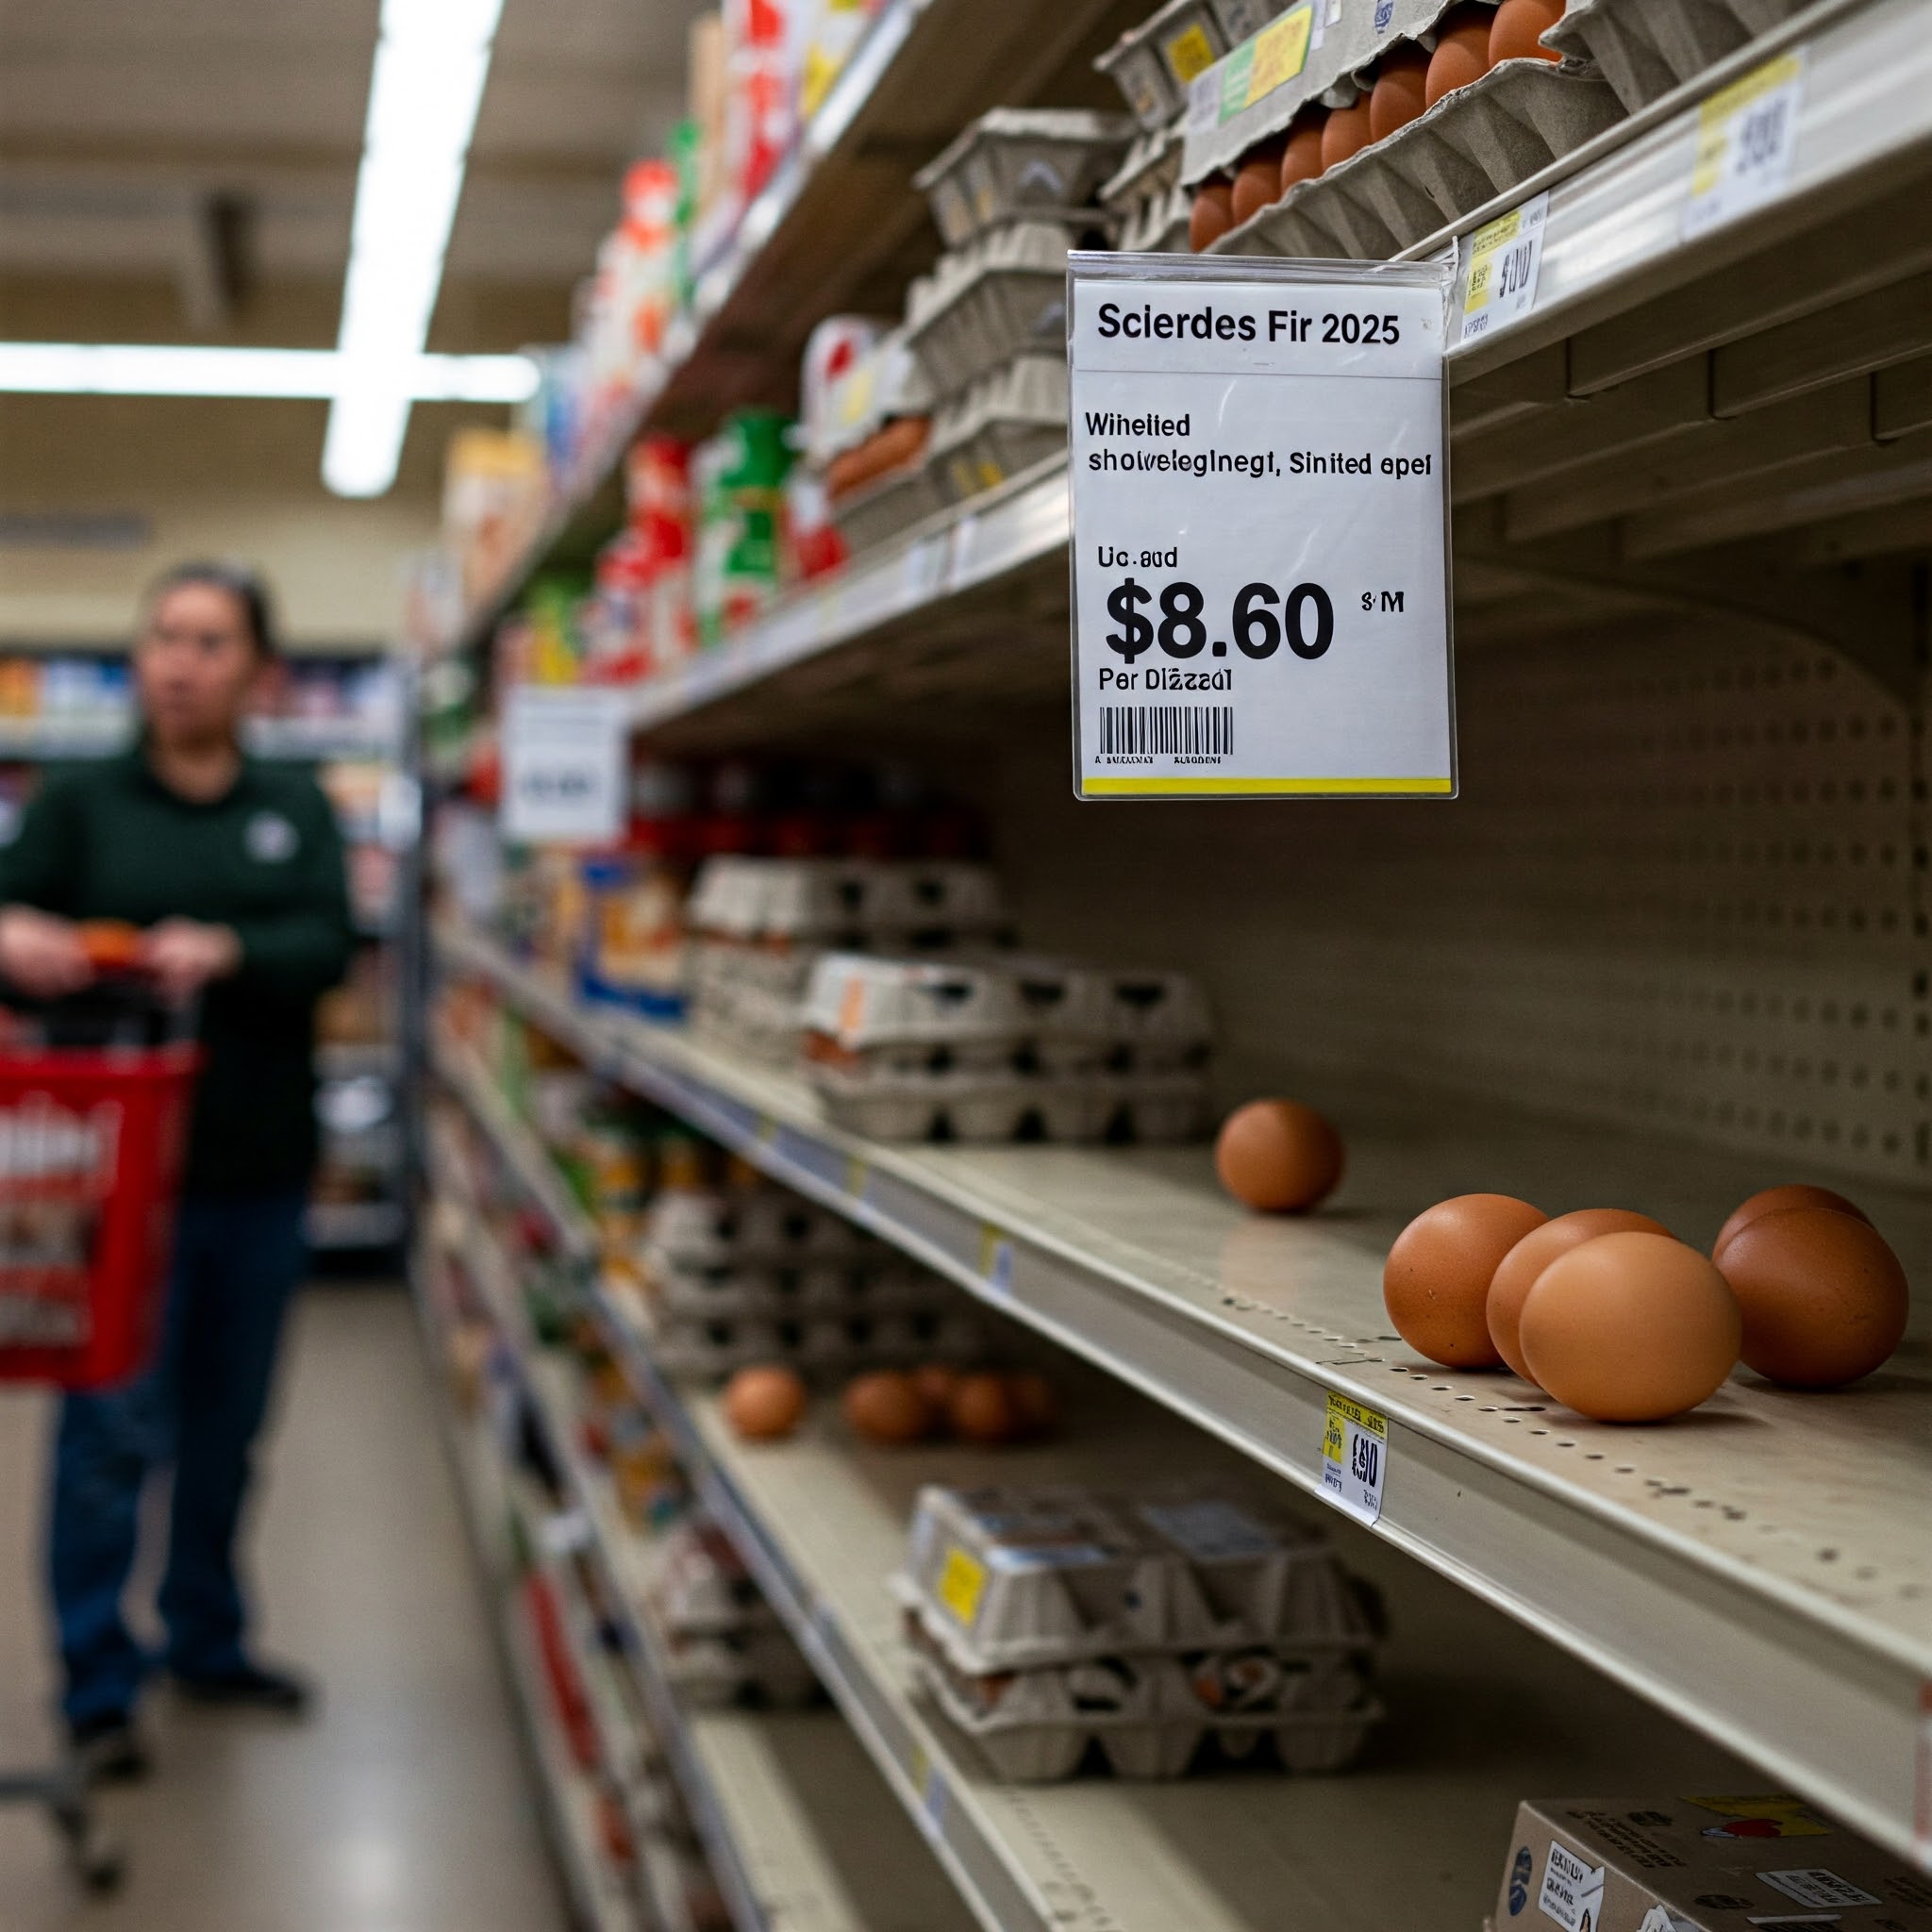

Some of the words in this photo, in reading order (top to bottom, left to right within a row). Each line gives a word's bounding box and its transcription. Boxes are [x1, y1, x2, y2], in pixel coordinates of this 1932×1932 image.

[1097, 303, 1257, 341] Scierdes
[1268, 309, 1313, 342] Fir
[1322, 312, 1400, 345] 2025
[1105, 576, 1335, 665] $8.60
